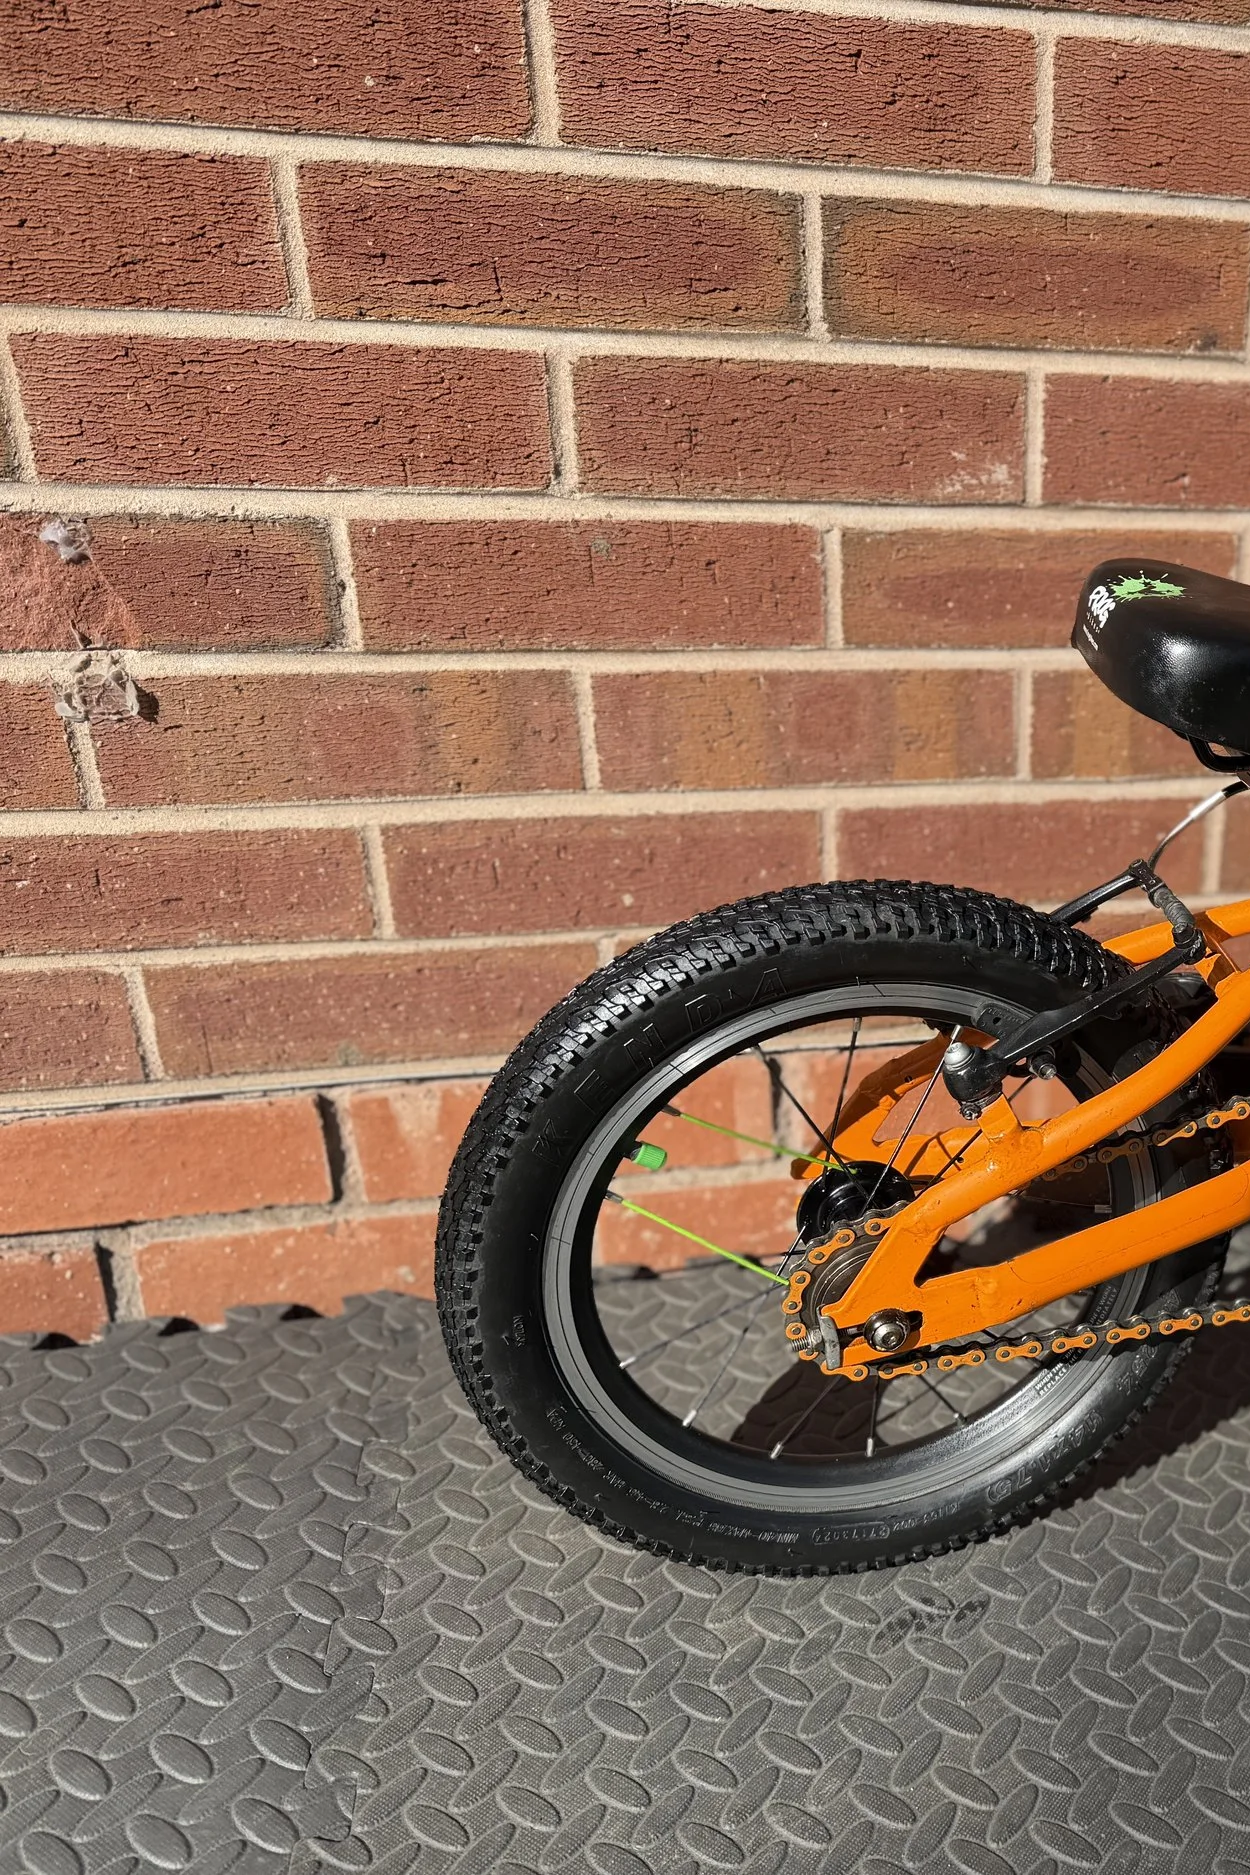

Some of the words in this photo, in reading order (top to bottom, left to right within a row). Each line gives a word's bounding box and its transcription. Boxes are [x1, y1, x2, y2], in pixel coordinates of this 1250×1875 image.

[1087, 585, 1116, 629] FROG
[529, 967, 788, 1168] KENDA
[1034, 1371, 1053, 1391] WHEN
[1038, 1366, 1066, 1397] REPLACE
